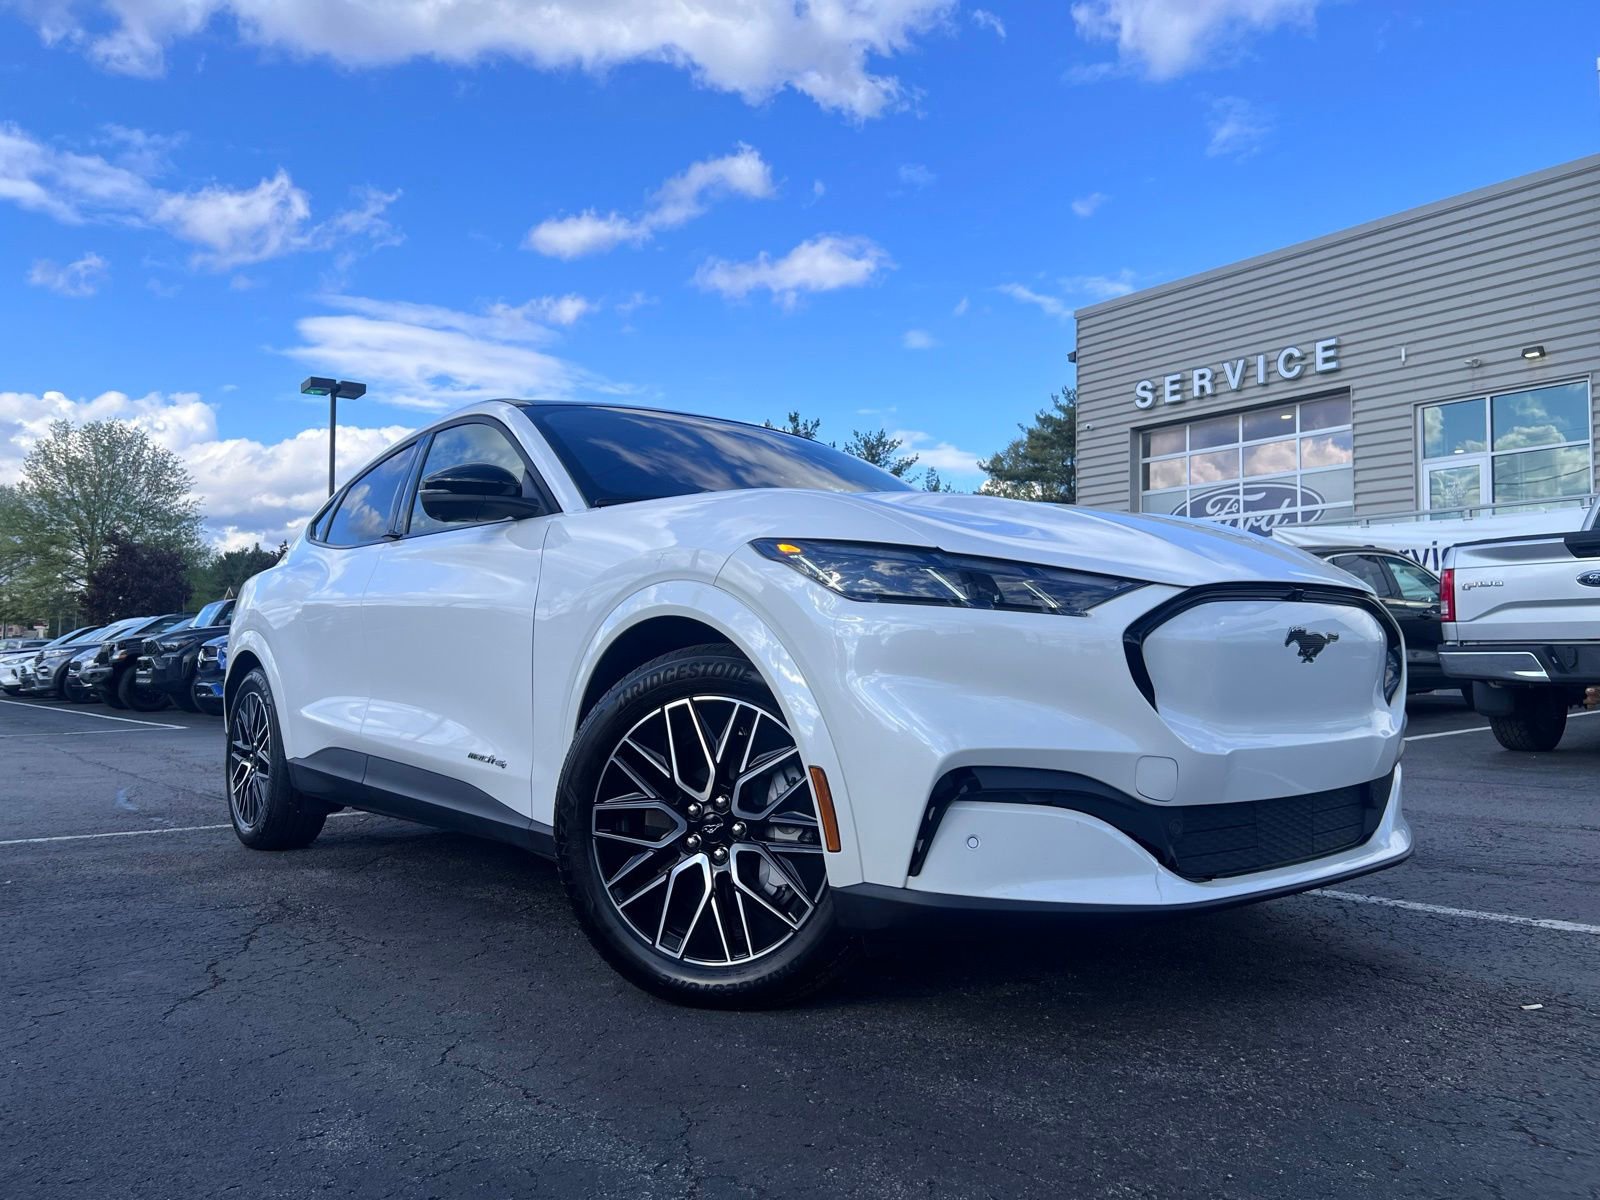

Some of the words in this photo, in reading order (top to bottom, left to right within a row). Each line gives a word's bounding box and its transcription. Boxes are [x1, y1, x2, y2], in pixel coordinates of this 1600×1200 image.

[1135, 337, 1340, 410] SERVICE
[1205, 492, 1289, 532] Ford
[614, 661, 754, 709] BRIDGESTONE
